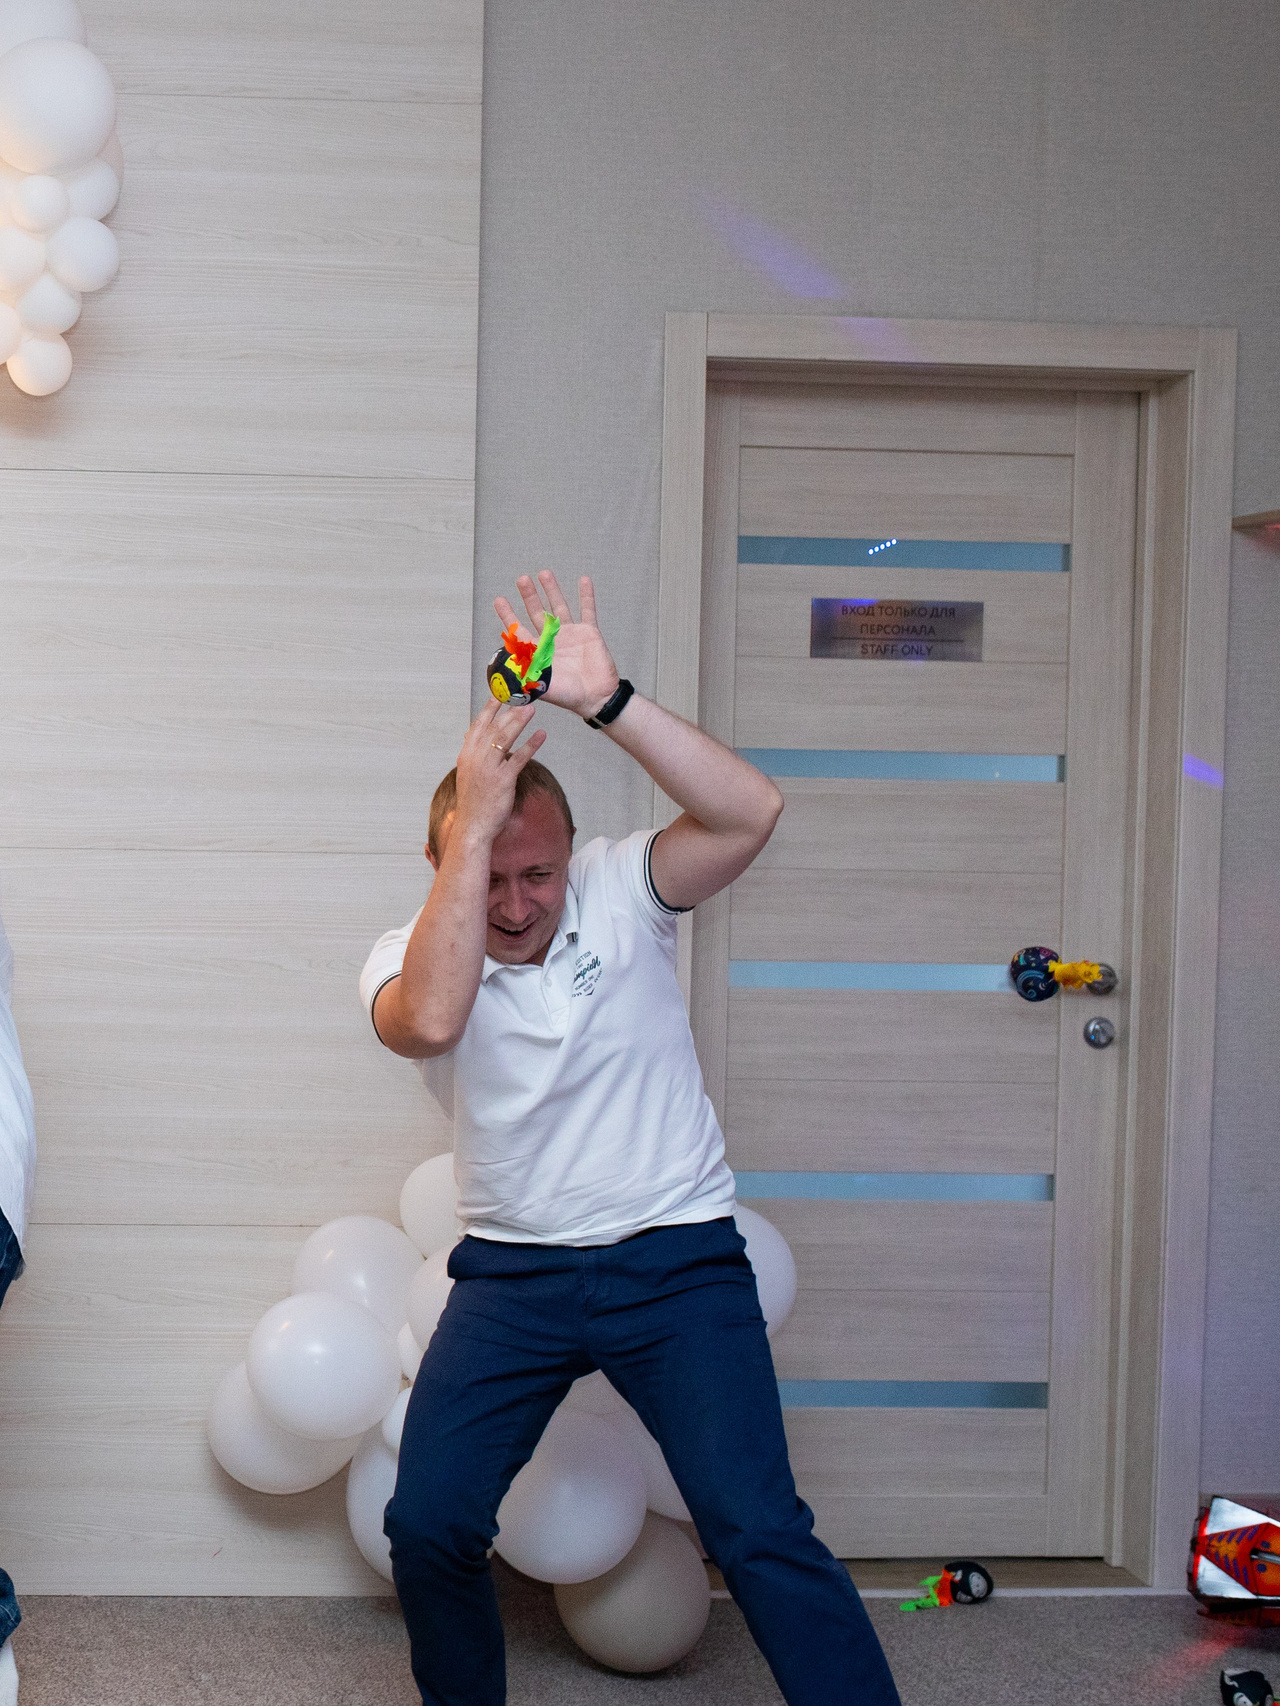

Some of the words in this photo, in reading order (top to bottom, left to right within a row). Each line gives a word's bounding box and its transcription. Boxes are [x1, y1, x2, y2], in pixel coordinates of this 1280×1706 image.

[841, 604, 875, 617] ВХОД
[879, 605, 928, 618] ТОЛЬКО
[930, 606, 956, 619] ДЛЯ
[860, 623, 936, 637] ПЕРСОНАЛА
[860, 643, 895, 655] STAFF
[901, 644, 933, 656] ONLY
